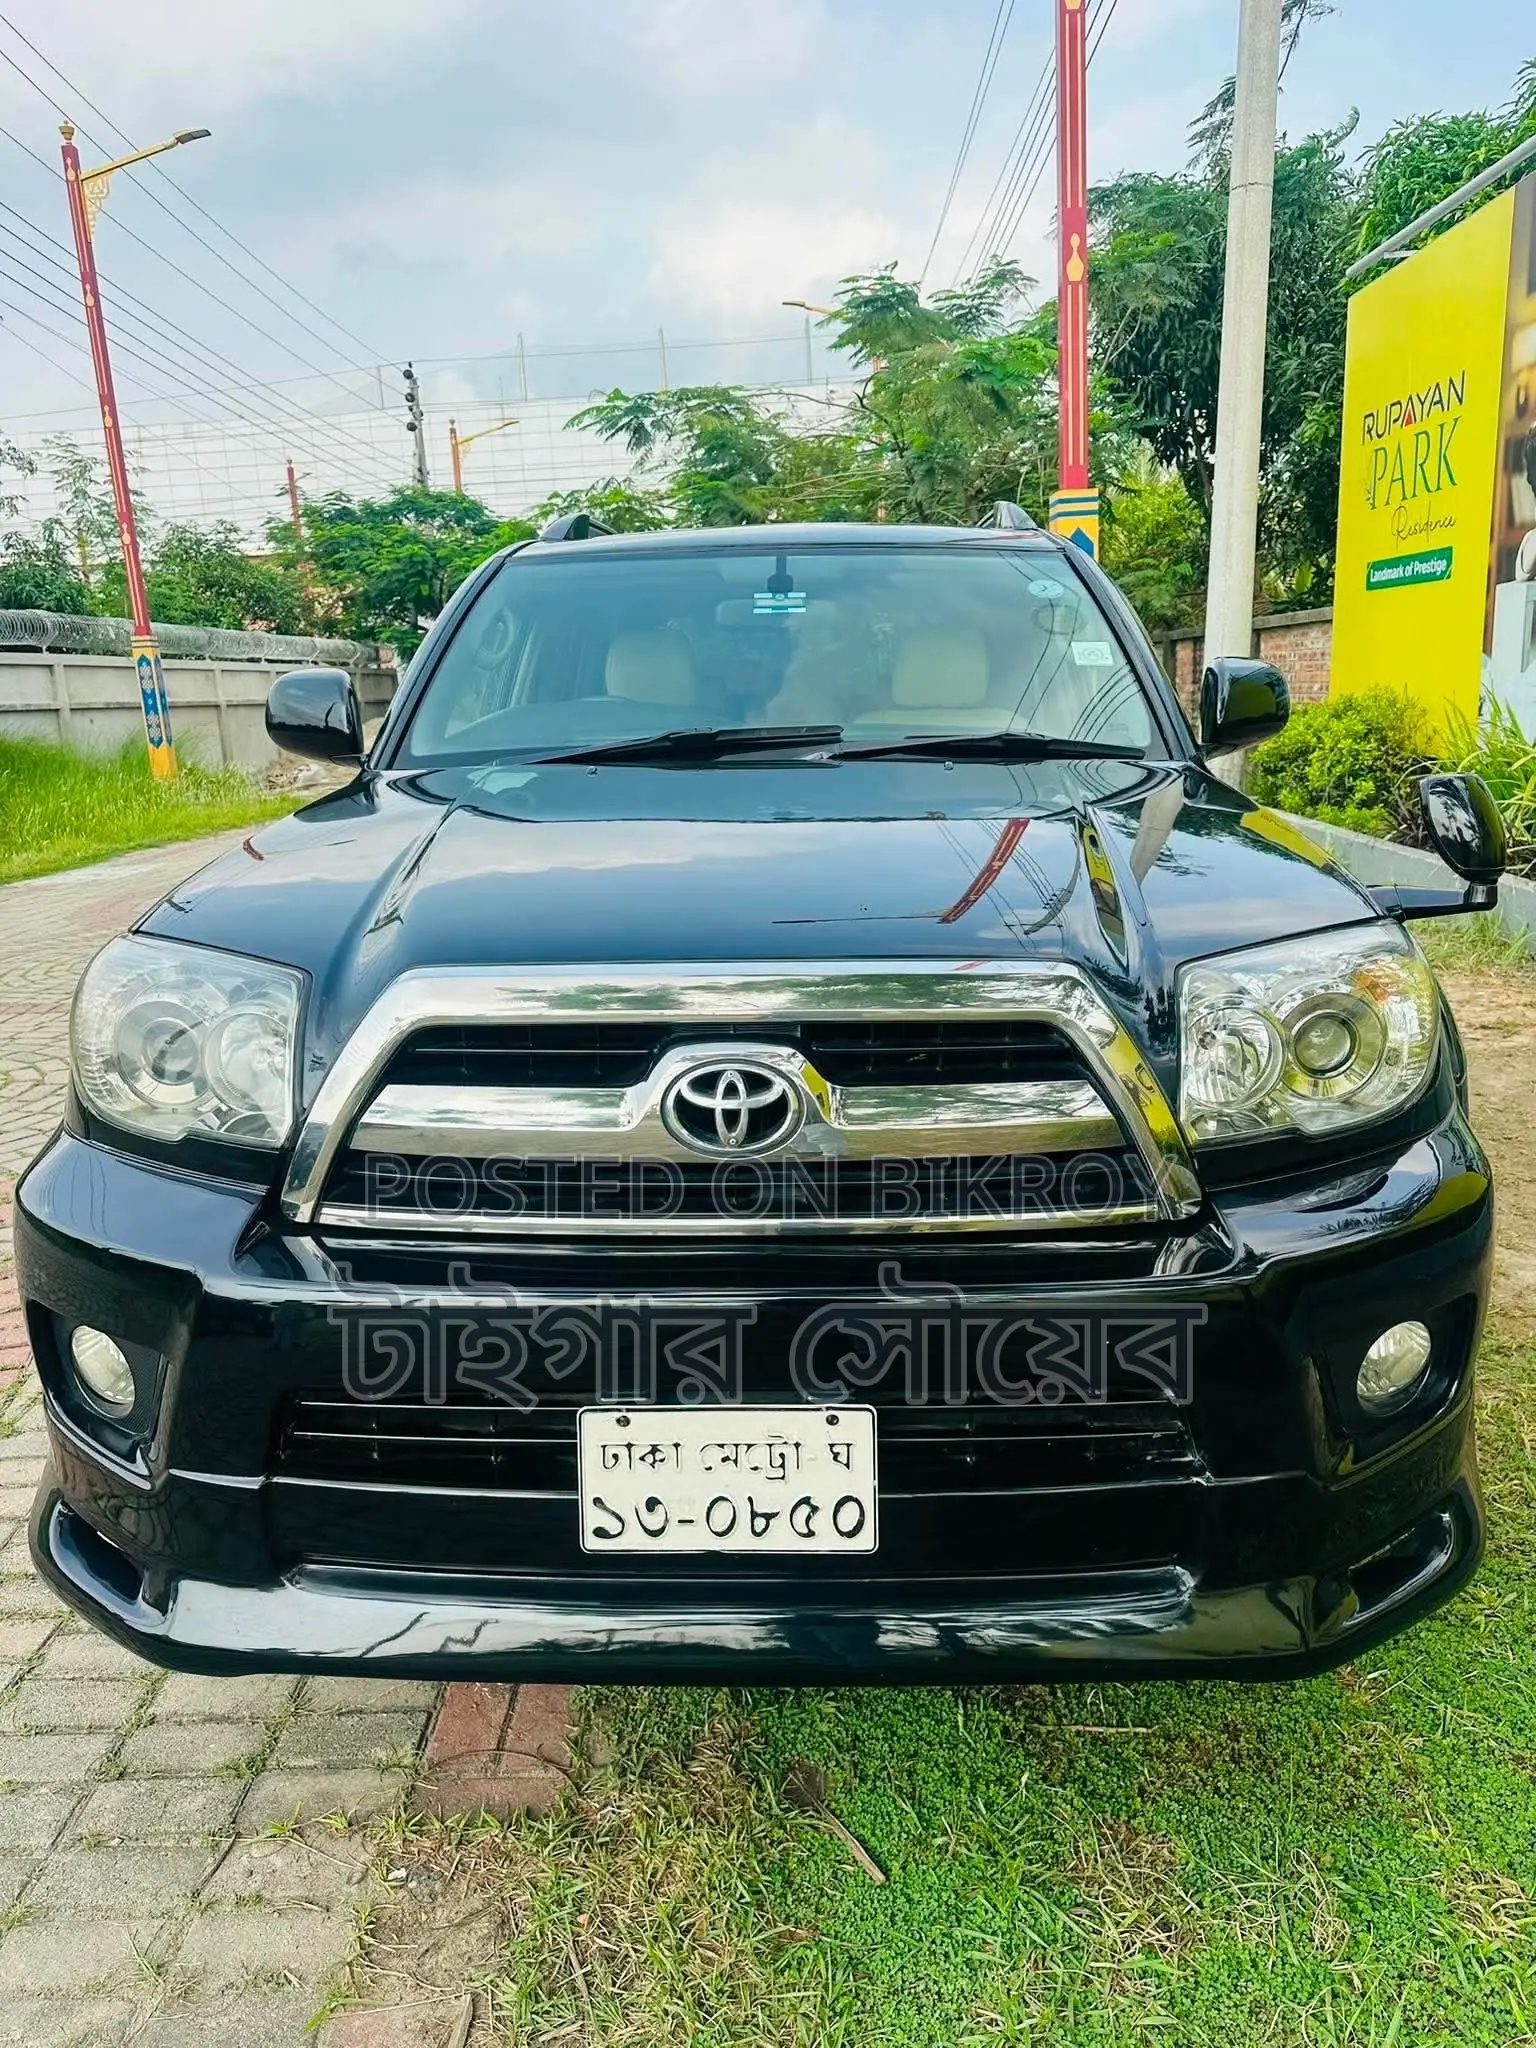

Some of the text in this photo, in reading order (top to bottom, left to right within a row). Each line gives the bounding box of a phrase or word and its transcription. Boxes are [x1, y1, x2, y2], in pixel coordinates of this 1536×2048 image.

[1362, 370, 1465, 446] RUPAYAN
[1369, 415, 1462, 510] PARK
[1391, 501, 1457, 552] Residence
[1370, 556, 1447, 582] Landmark of Prestige
[600, 1434, 854, 1481] ঢাকা মেট্রো ঘ
[592, 1495, 866, 1540] ১৩-০৮৫০
